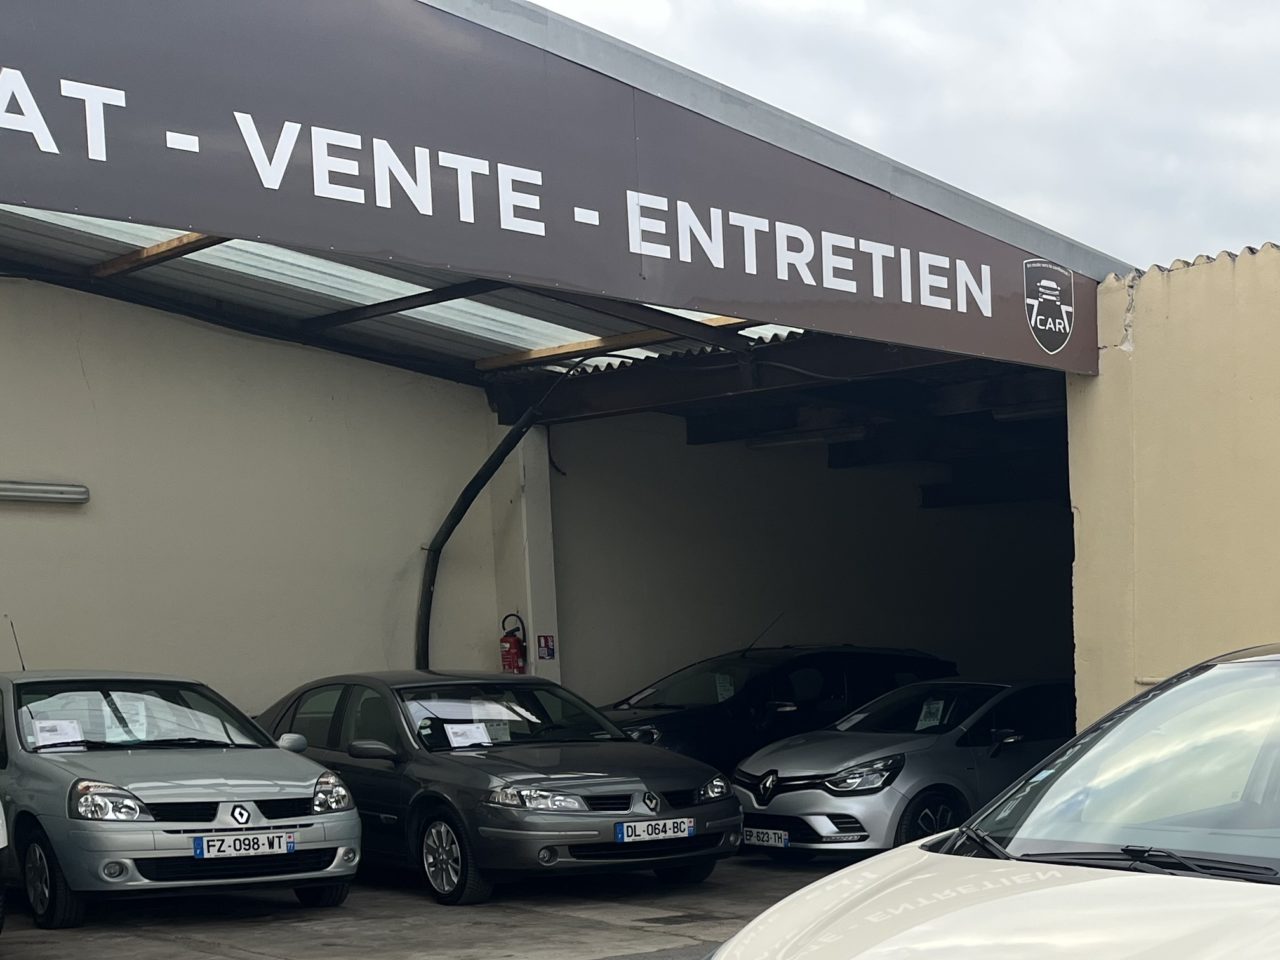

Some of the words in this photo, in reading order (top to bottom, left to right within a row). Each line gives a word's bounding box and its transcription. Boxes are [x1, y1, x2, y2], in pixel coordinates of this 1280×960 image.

[0, 67, 126, 162] AT
[233, 111, 546, 237] VENTE
[626, 189, 993, 318] ENTRETIEN
[626, 820, 686, 838] DL-064-BC
[206, 835, 284, 854] FZ-098-WT
